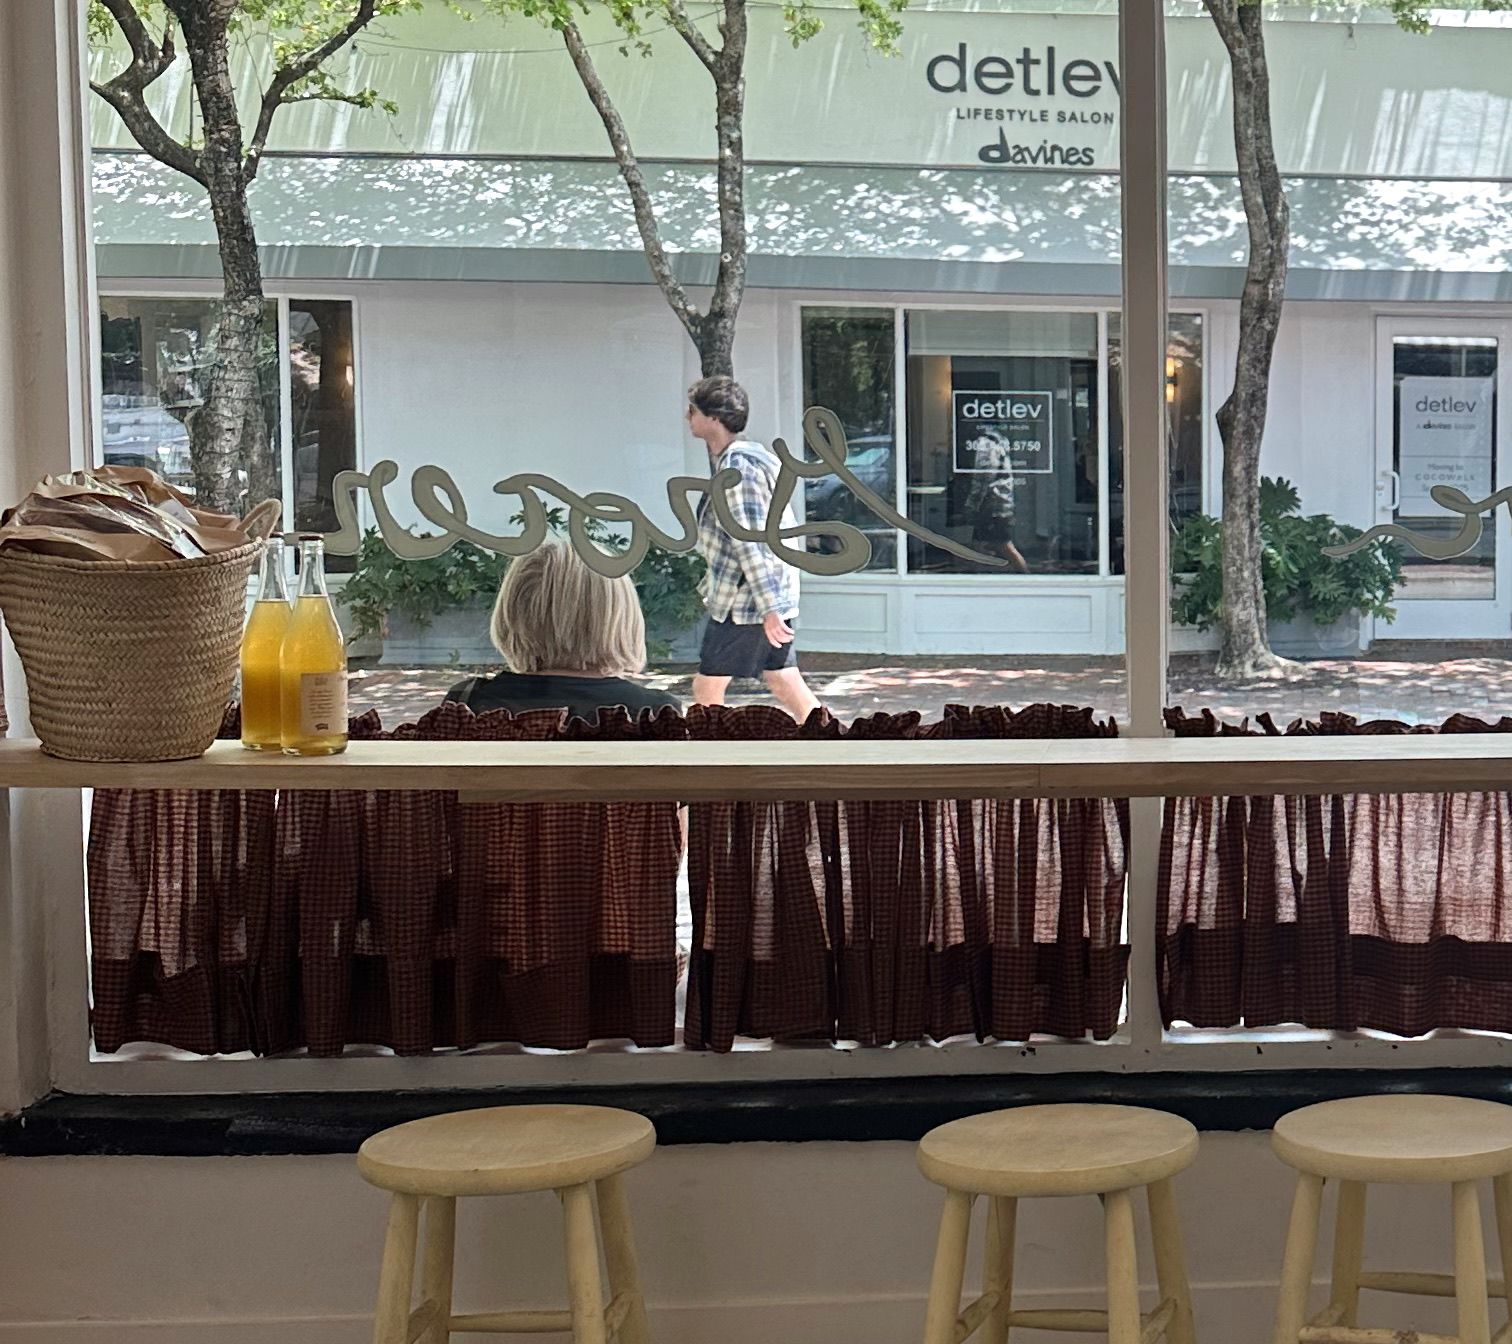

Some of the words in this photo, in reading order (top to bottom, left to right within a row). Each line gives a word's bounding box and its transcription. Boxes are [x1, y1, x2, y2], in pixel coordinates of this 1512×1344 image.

[956, 107, 1049, 123] LIFESTYLE
[1057, 110, 1115, 125] SALON
[978, 125, 1095, 166] davines
[963, 398, 1042, 419] detlev
[1415, 395, 1477, 413] detlev
[965, 439, 1042, 452] 30.5750
